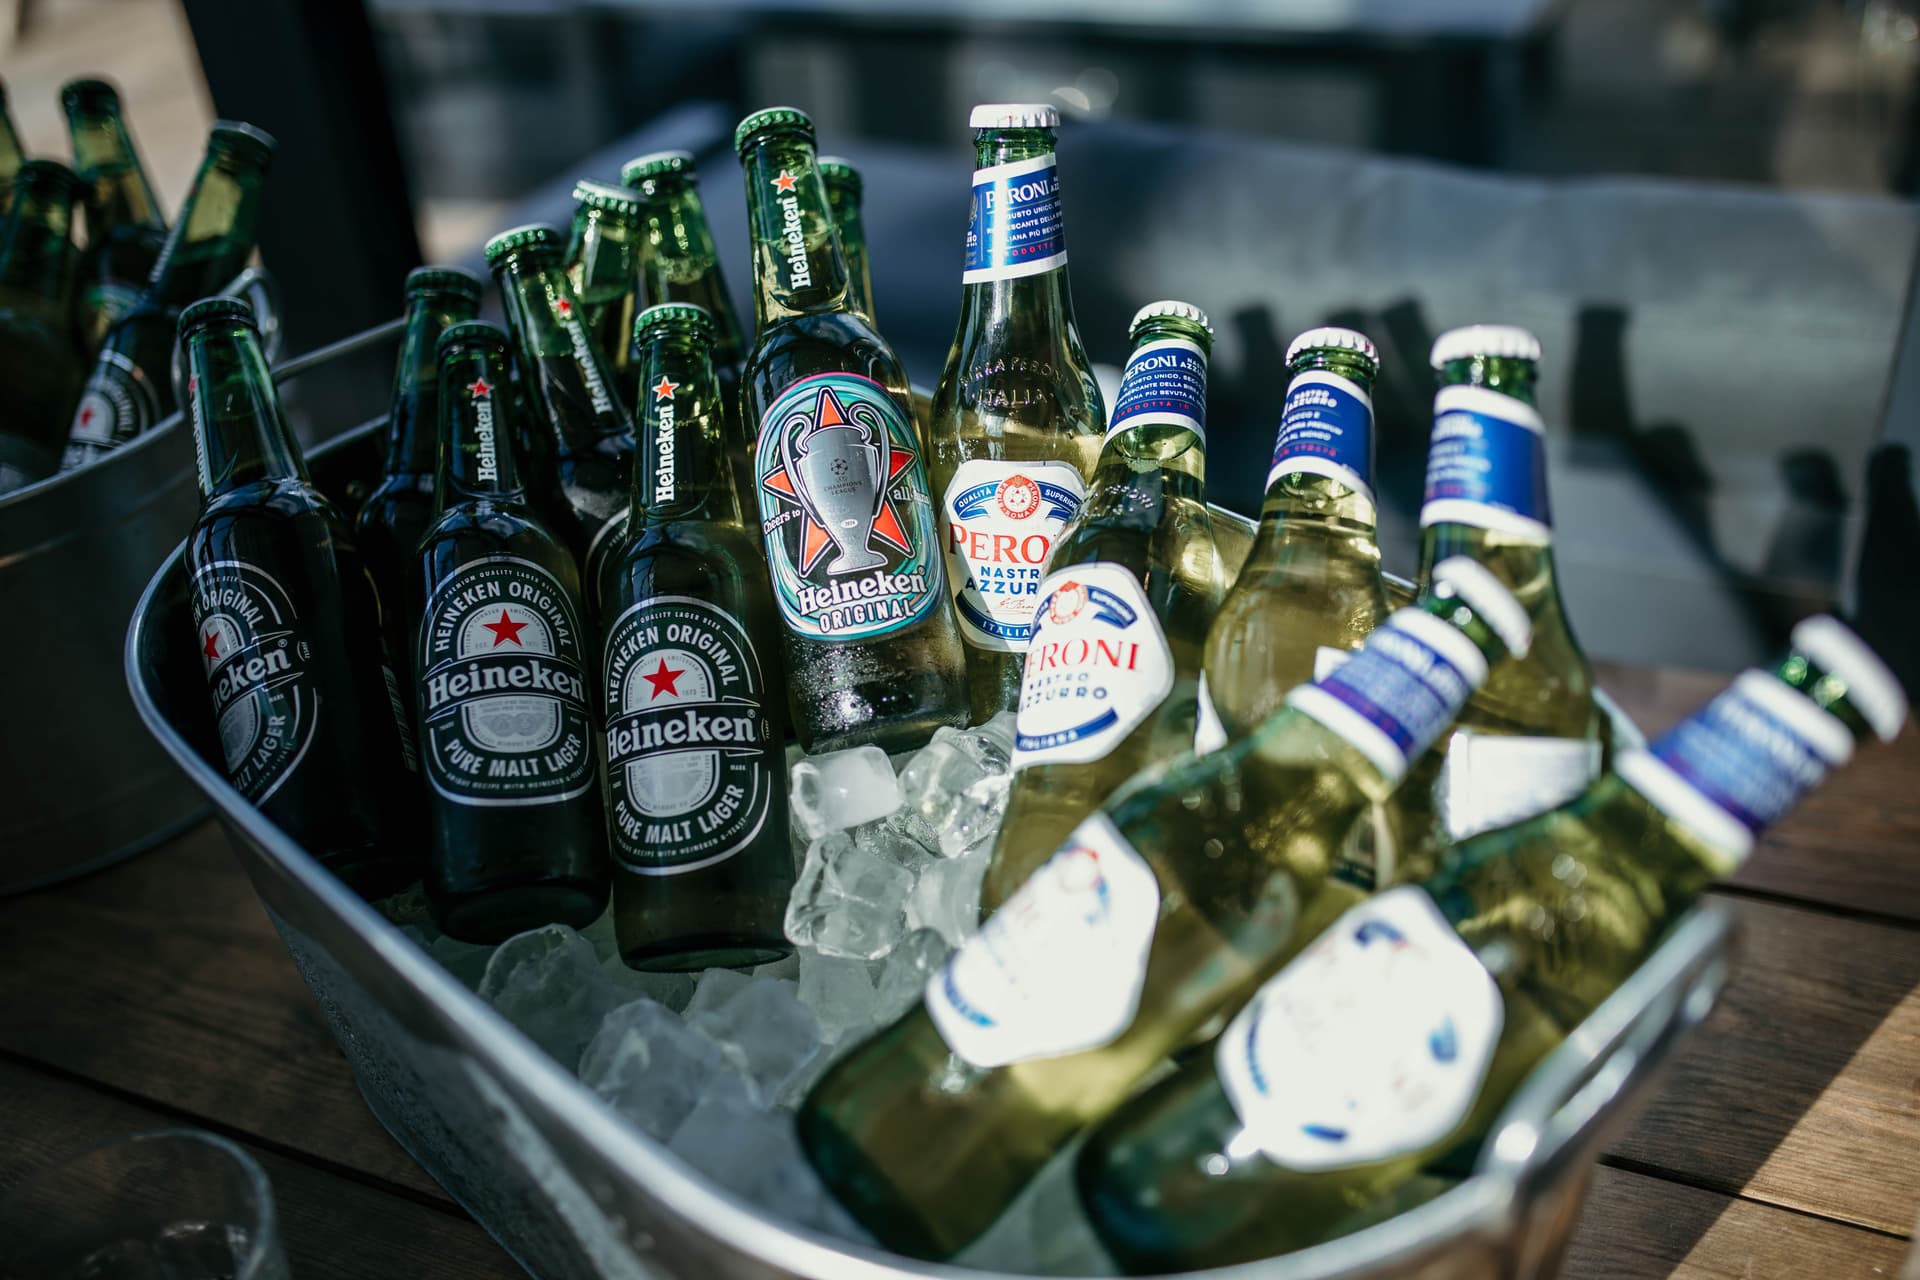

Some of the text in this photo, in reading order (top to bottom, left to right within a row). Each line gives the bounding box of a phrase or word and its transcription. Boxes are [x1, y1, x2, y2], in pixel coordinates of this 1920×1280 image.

[985, 179, 1049, 208] PRONI
[776, 196, 811, 290] Heineken
[1124, 355, 1178, 381] PERONI
[471, 399, 497, 482] Heineken
[655, 403, 675, 504] Heineken
[1045, 489, 1078, 510] SUPERIOR
[949, 522, 1051, 564] PERO
[479, 569, 513, 578] QUALITY
[797, 569, 928, 616] Heineken
[965, 577, 1039, 595] AZZUR
[981, 566, 1040, 580] NASTR
[202, 588, 264, 629] ORIGINAL
[434, 580, 501, 653] HEINEKEN
[508, 580, 572, 647] ORIGINAL
[640, 611, 672, 624] QUALITY
[675, 611, 700, 621] LAGER
[818, 597, 916, 632] ORIGINAL
[982, 621, 1030, 637] ITALIA
[213, 648, 292, 710] neken
[609, 625, 660, 704] HEINEKEN
[666, 623, 740, 687] ORIGINAL
[1026, 639, 1139, 679] ERONI
[427, 659, 585, 710] Heineken
[252, 715, 286, 770] LAGER
[444, 733, 582, 777] PURE MALT LAGER
[607, 710, 757, 764] Heineken
[615, 784, 745, 844] PURE MALT LAGER
